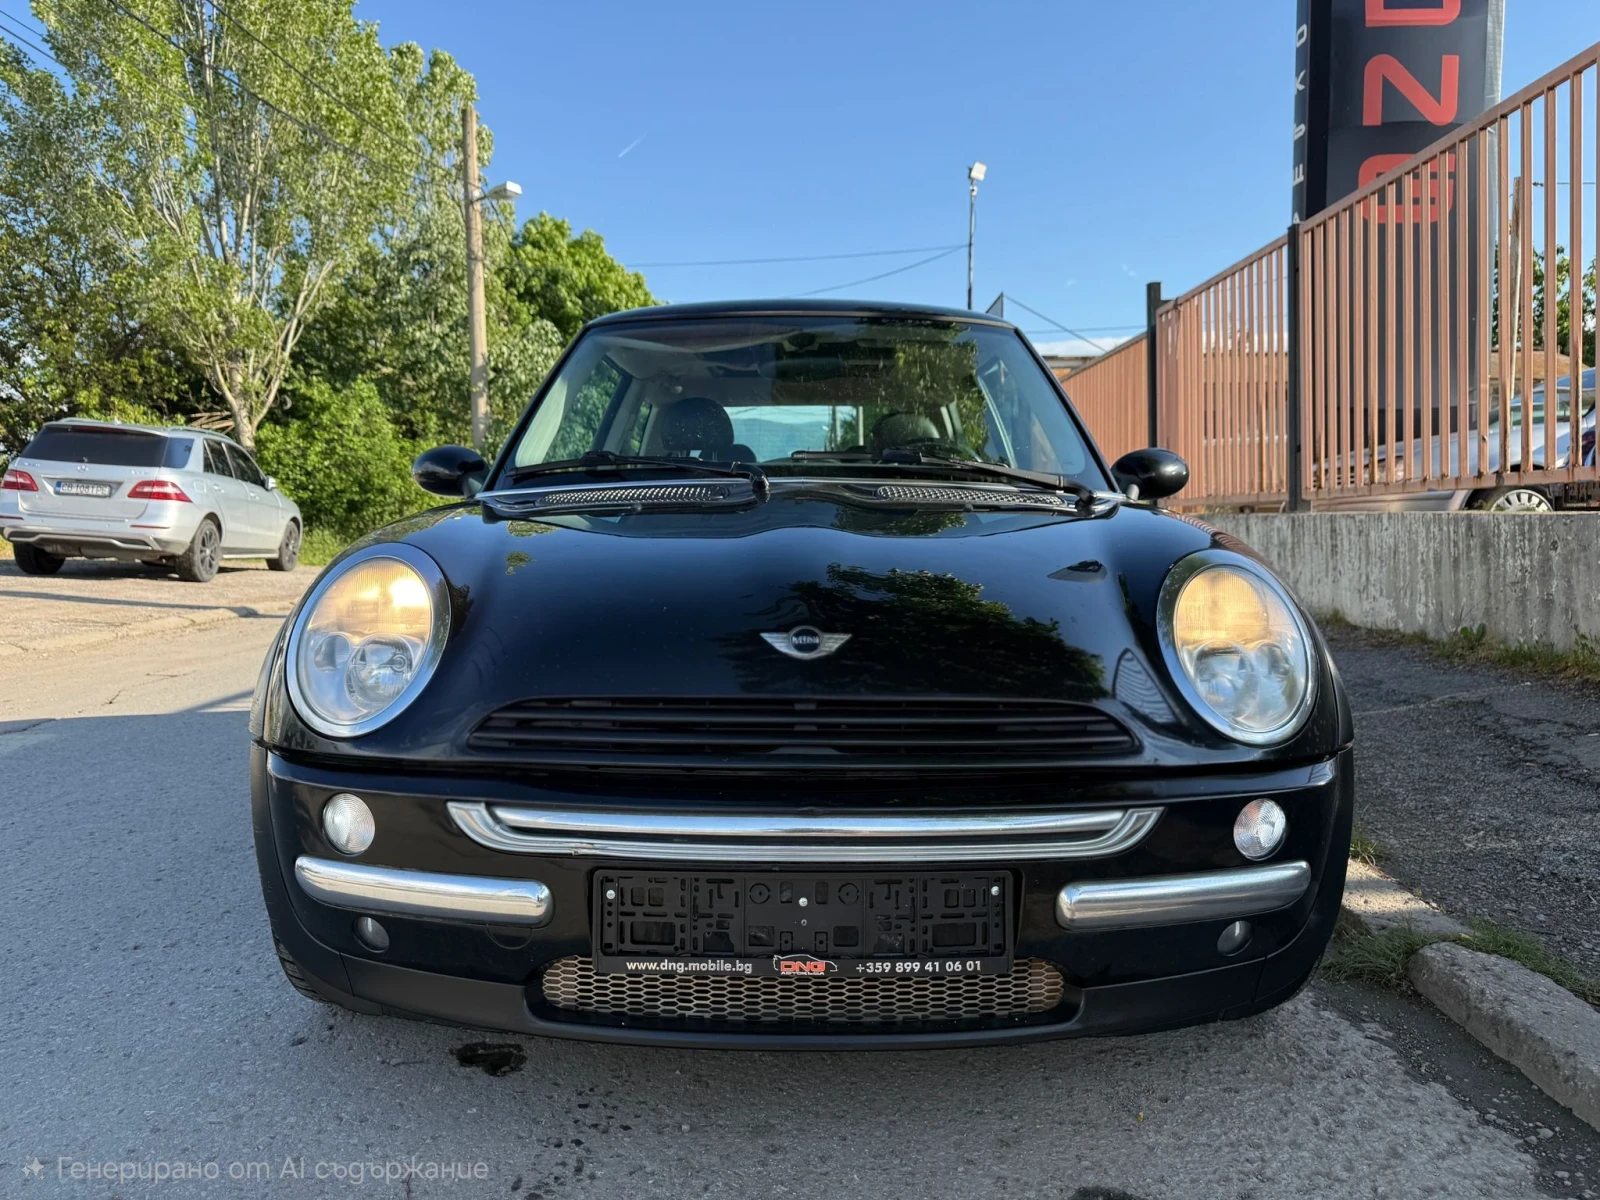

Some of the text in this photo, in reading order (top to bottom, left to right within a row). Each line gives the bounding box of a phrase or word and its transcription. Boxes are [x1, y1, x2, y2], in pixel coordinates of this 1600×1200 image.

[792, 635, 819, 644] MINI
[626, 959, 752, 973] www.dng.mobile.bg
[780, 961, 826, 972] DNG
[856, 960, 981, 973] +359 899 41 06 01
